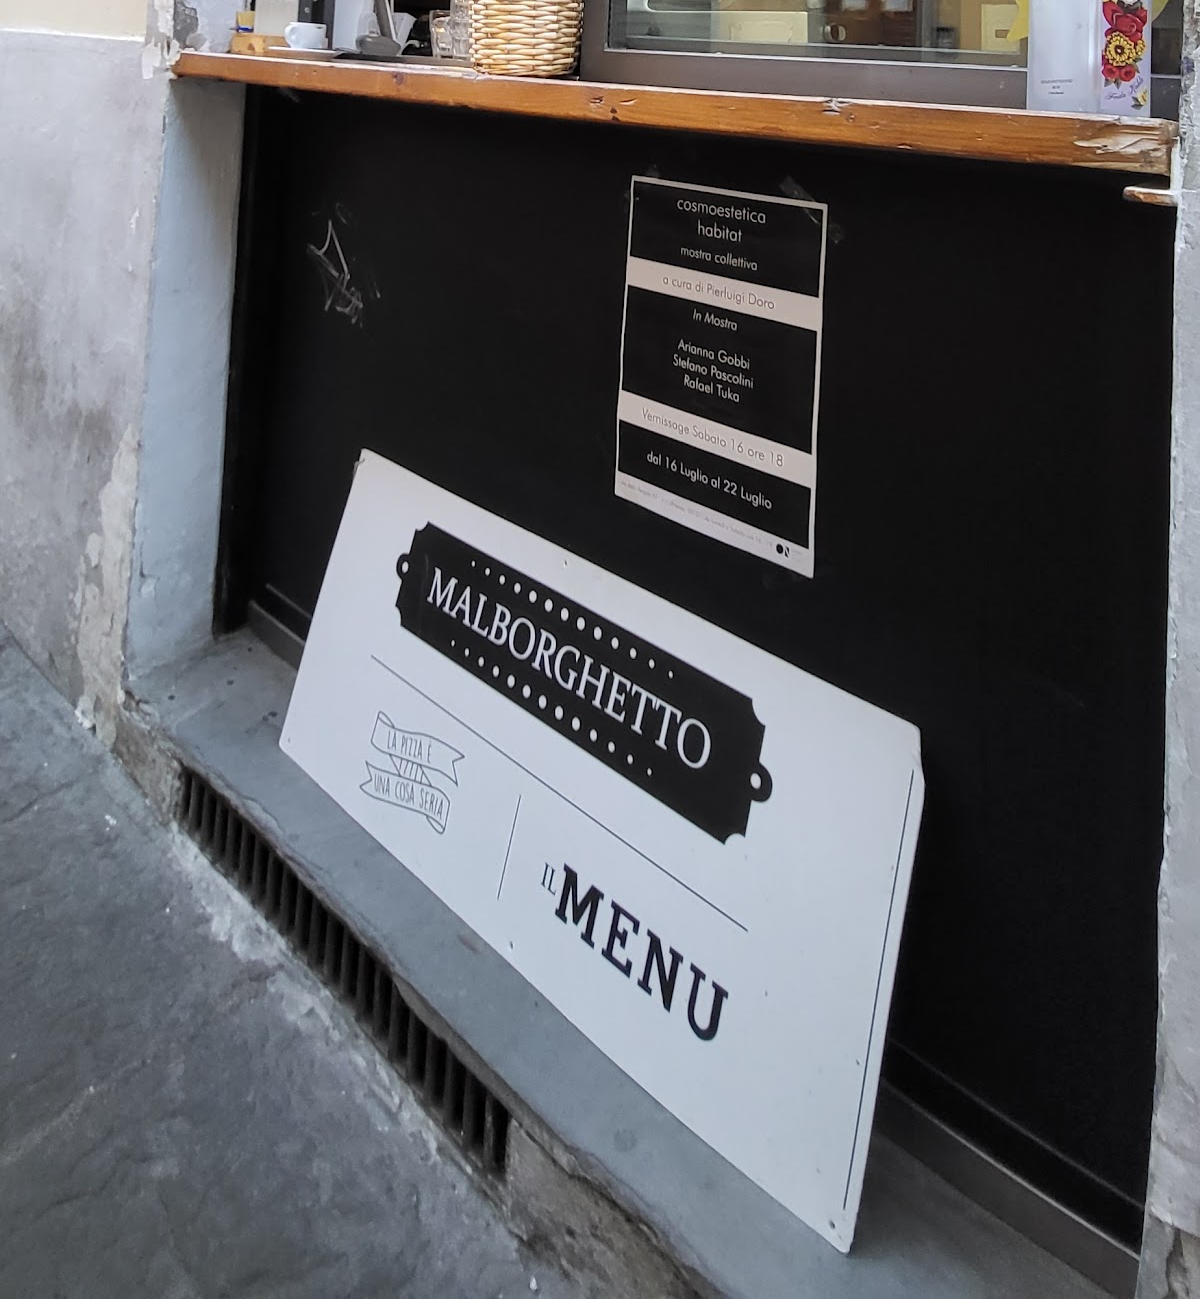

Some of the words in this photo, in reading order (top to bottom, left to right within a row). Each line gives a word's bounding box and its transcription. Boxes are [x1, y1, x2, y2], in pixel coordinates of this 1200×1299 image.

[676, 199, 766, 223] cosmoestetica
[697, 219, 742, 242] habitat
[680, 247, 711, 261] mostra
[714, 252, 758, 271] collettiva
[662, 276, 669, 285] a
[671, 279, 692, 290] cura
[695, 282, 704, 293] di
[706, 283, 745, 305] Pierluigi
[748, 293, 775, 310] Doro
[692, 308, 702, 321] In
[704, 311, 738, 331] Mostra
[677, 338, 715, 360] Arianna
[717, 349, 750, 370] Gobbi
[672, 353, 708, 375] Stefano
[710, 365, 754, 389] Pascolini
[683, 374, 714, 395] Rafael
[716, 383, 740, 403] Tuka
[641, 407, 690, 435] Vernissage
[692, 425, 727, 448] Sabato
[730, 438, 744, 453] 16
[747, 448, 765, 461] ore
[769, 451, 784, 467] 18
[646, 450, 662, 466] dal
[665, 456, 678, 472] 16
[680, 462, 709, 485] Luglio
[710, 476, 721, 490] al
[723, 479, 738, 496] 22
[740, 485, 773, 510] Luglio
[426, 567, 712, 769] MALBORGHETTO
[387, 730, 397, 751] LA
[400, 735, 422, 760] PIZZA
[374, 772, 390, 797] UNA
[395, 781, 415, 805] COSA
[419, 788, 444, 820] SERIA
[540, 862, 557, 897] IL
[555, 862, 729, 1042] MENU
